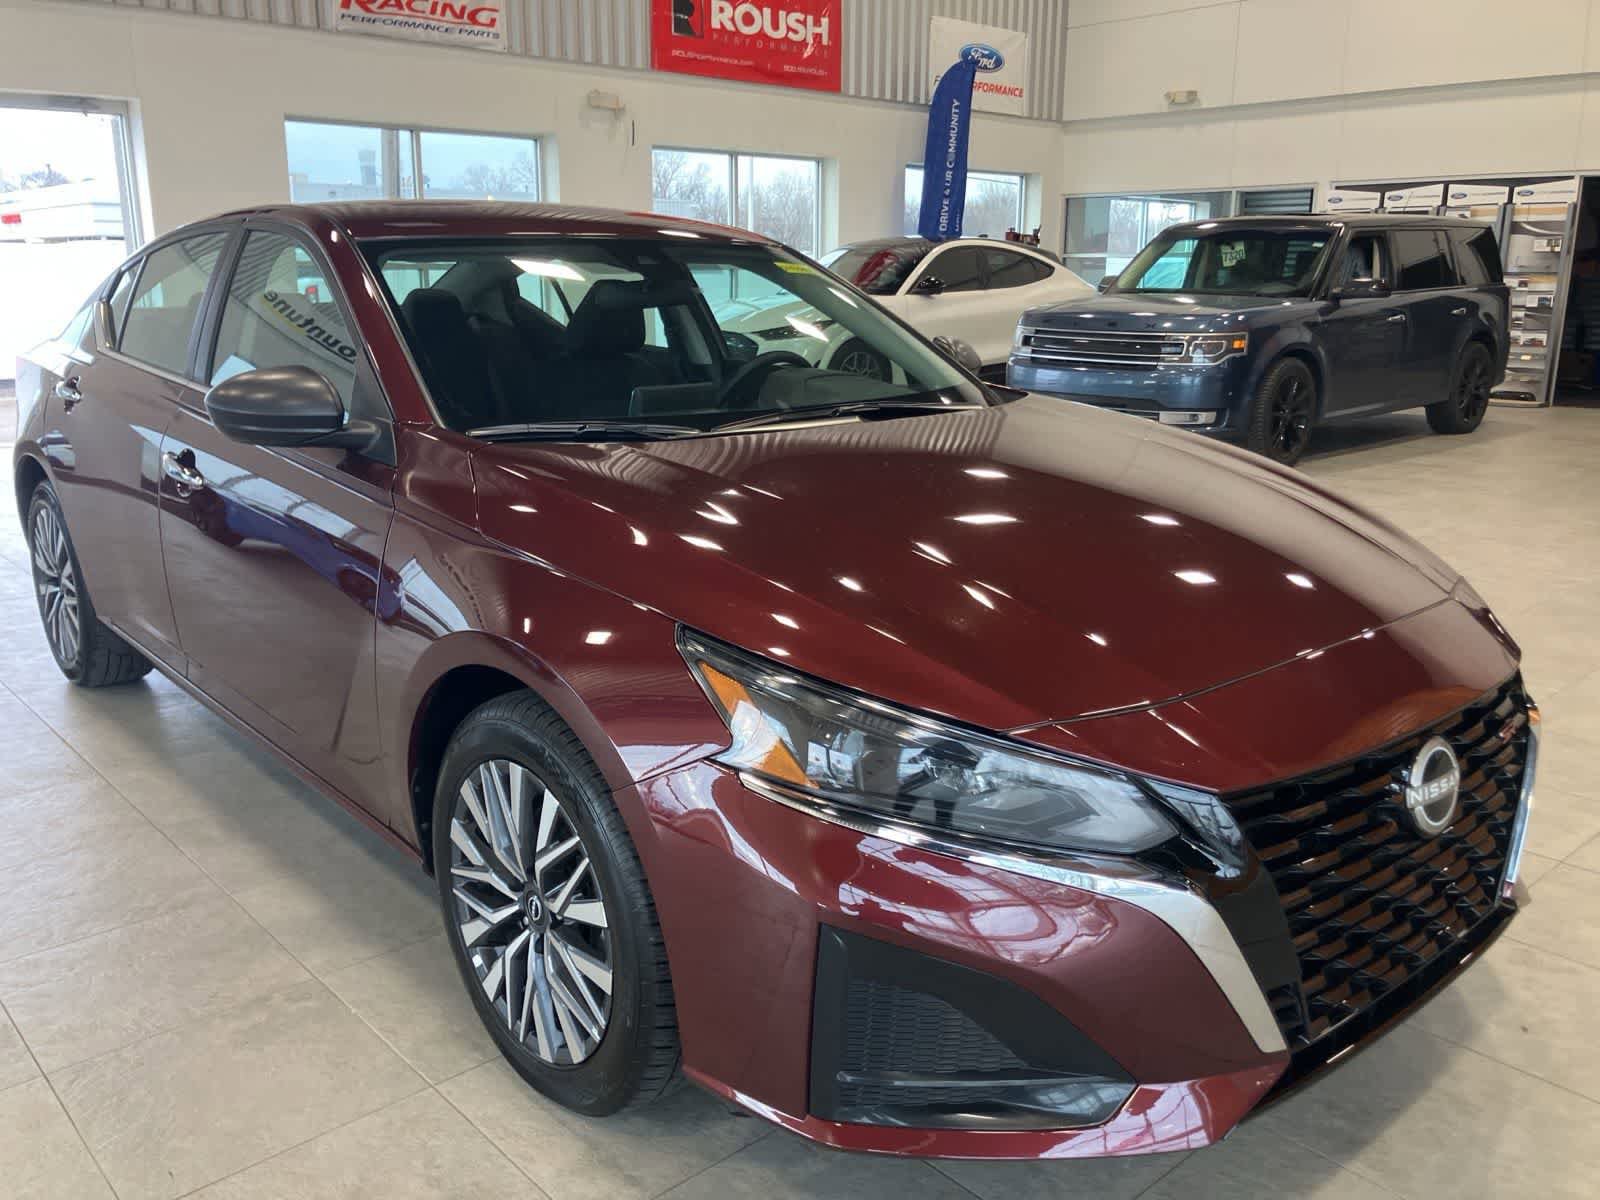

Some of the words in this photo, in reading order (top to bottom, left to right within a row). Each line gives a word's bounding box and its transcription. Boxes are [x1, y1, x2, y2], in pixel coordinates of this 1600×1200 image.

[340, 0, 499, 28] RACING
[340, 13, 454, 34] PERFORMANCE
[458, 28, 500, 40] PARTS
[711, 0, 829, 46] ROUSH
[972, 81, 1025, 98] RFORMANCE
[938, 198, 950, 232] DRIVE
[946, 98, 961, 169] COMMUNITY
